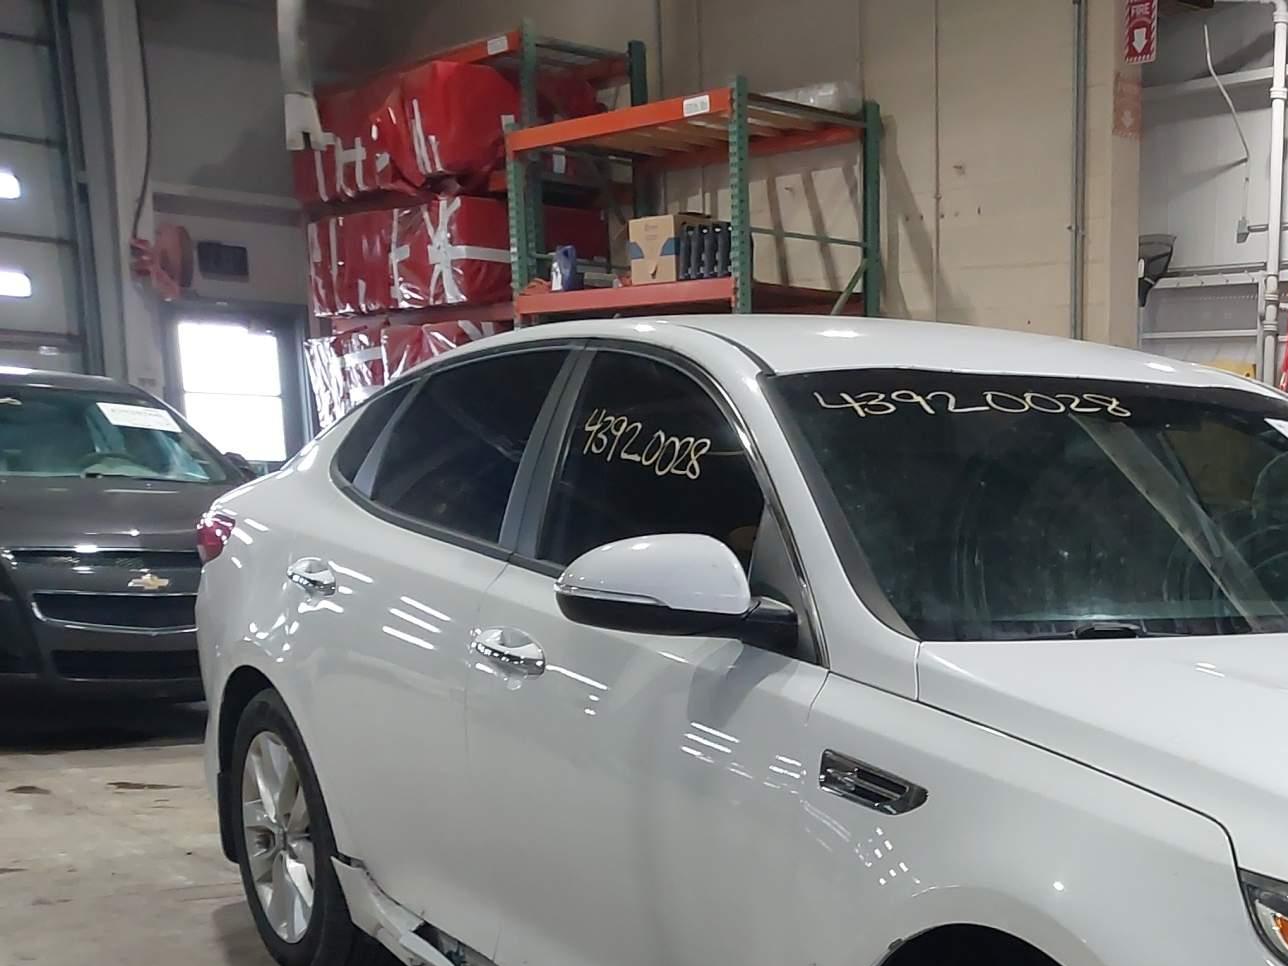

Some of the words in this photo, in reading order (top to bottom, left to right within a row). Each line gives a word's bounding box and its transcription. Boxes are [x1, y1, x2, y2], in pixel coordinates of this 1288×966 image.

[1131, 2, 1151, 16] FIRE
[814, 390, 1132, 418] 43920028
[583, 408, 711, 480] 43920028
